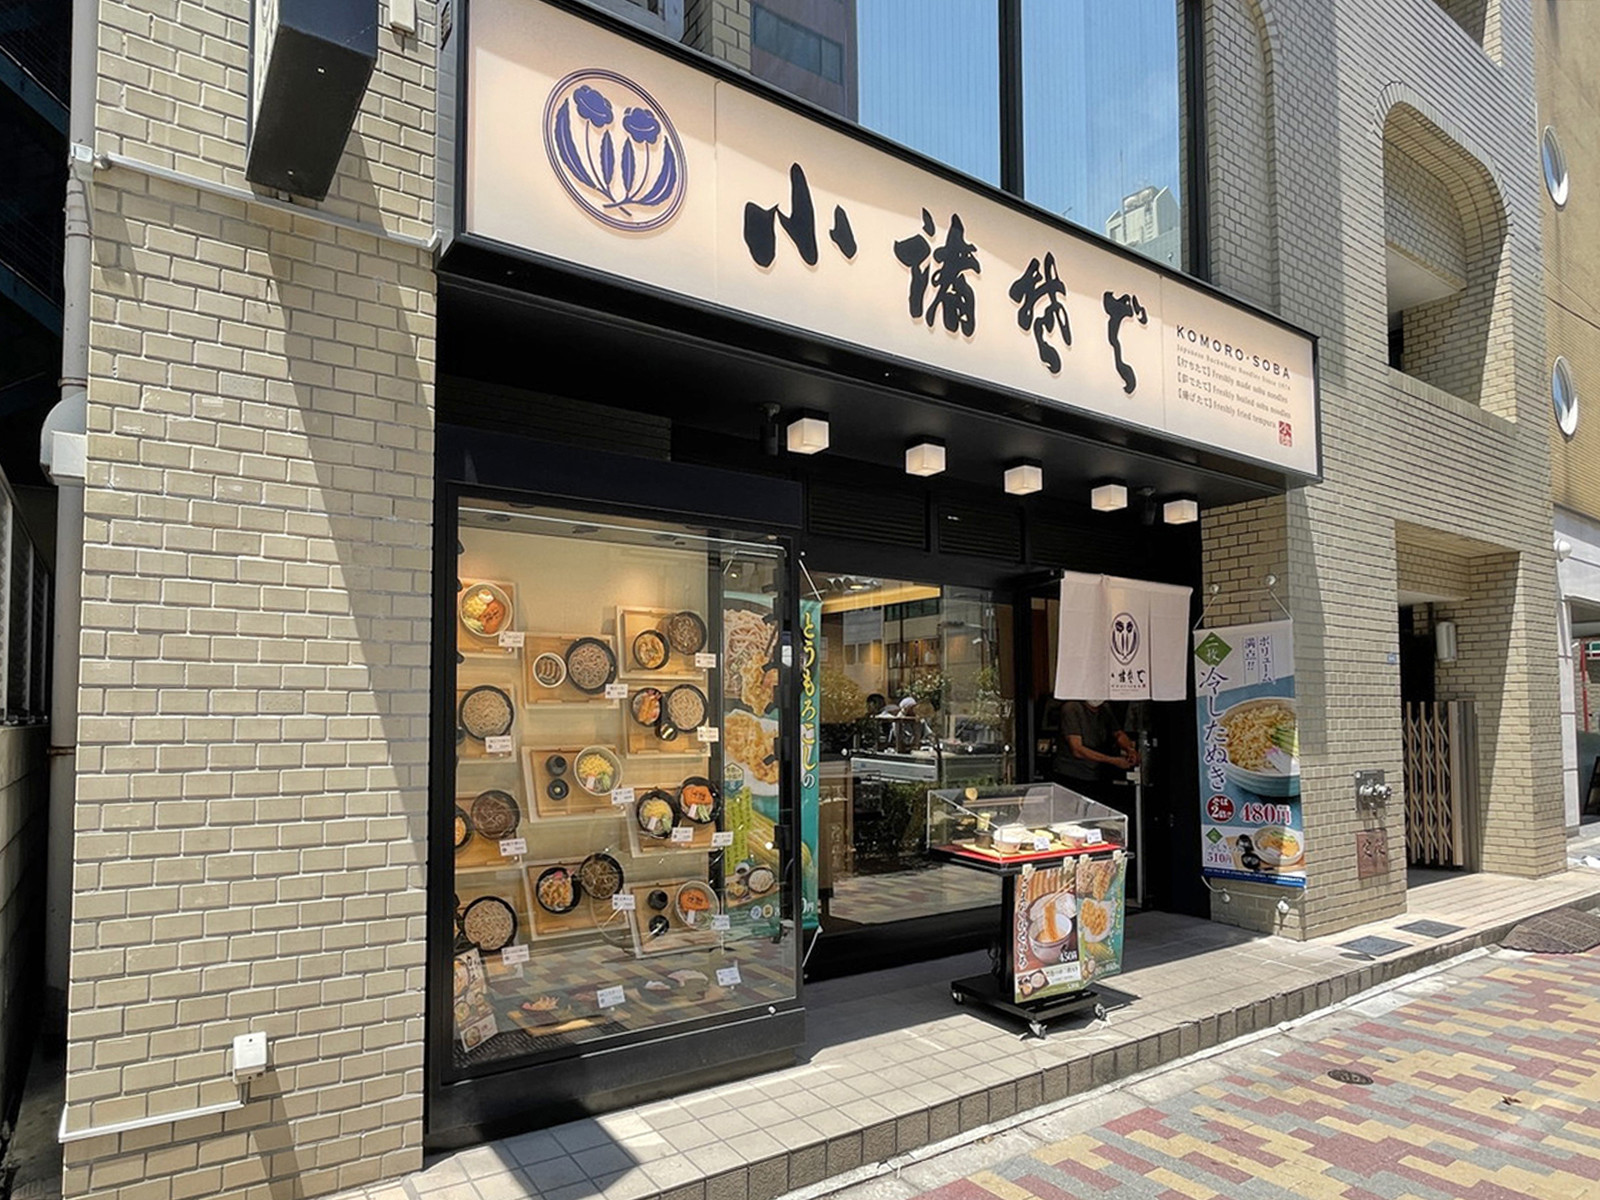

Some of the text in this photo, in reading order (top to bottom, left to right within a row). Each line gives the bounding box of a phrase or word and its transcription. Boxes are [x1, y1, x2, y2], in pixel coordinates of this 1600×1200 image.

[1198, 665, 1230, 790] 冷したぬき
